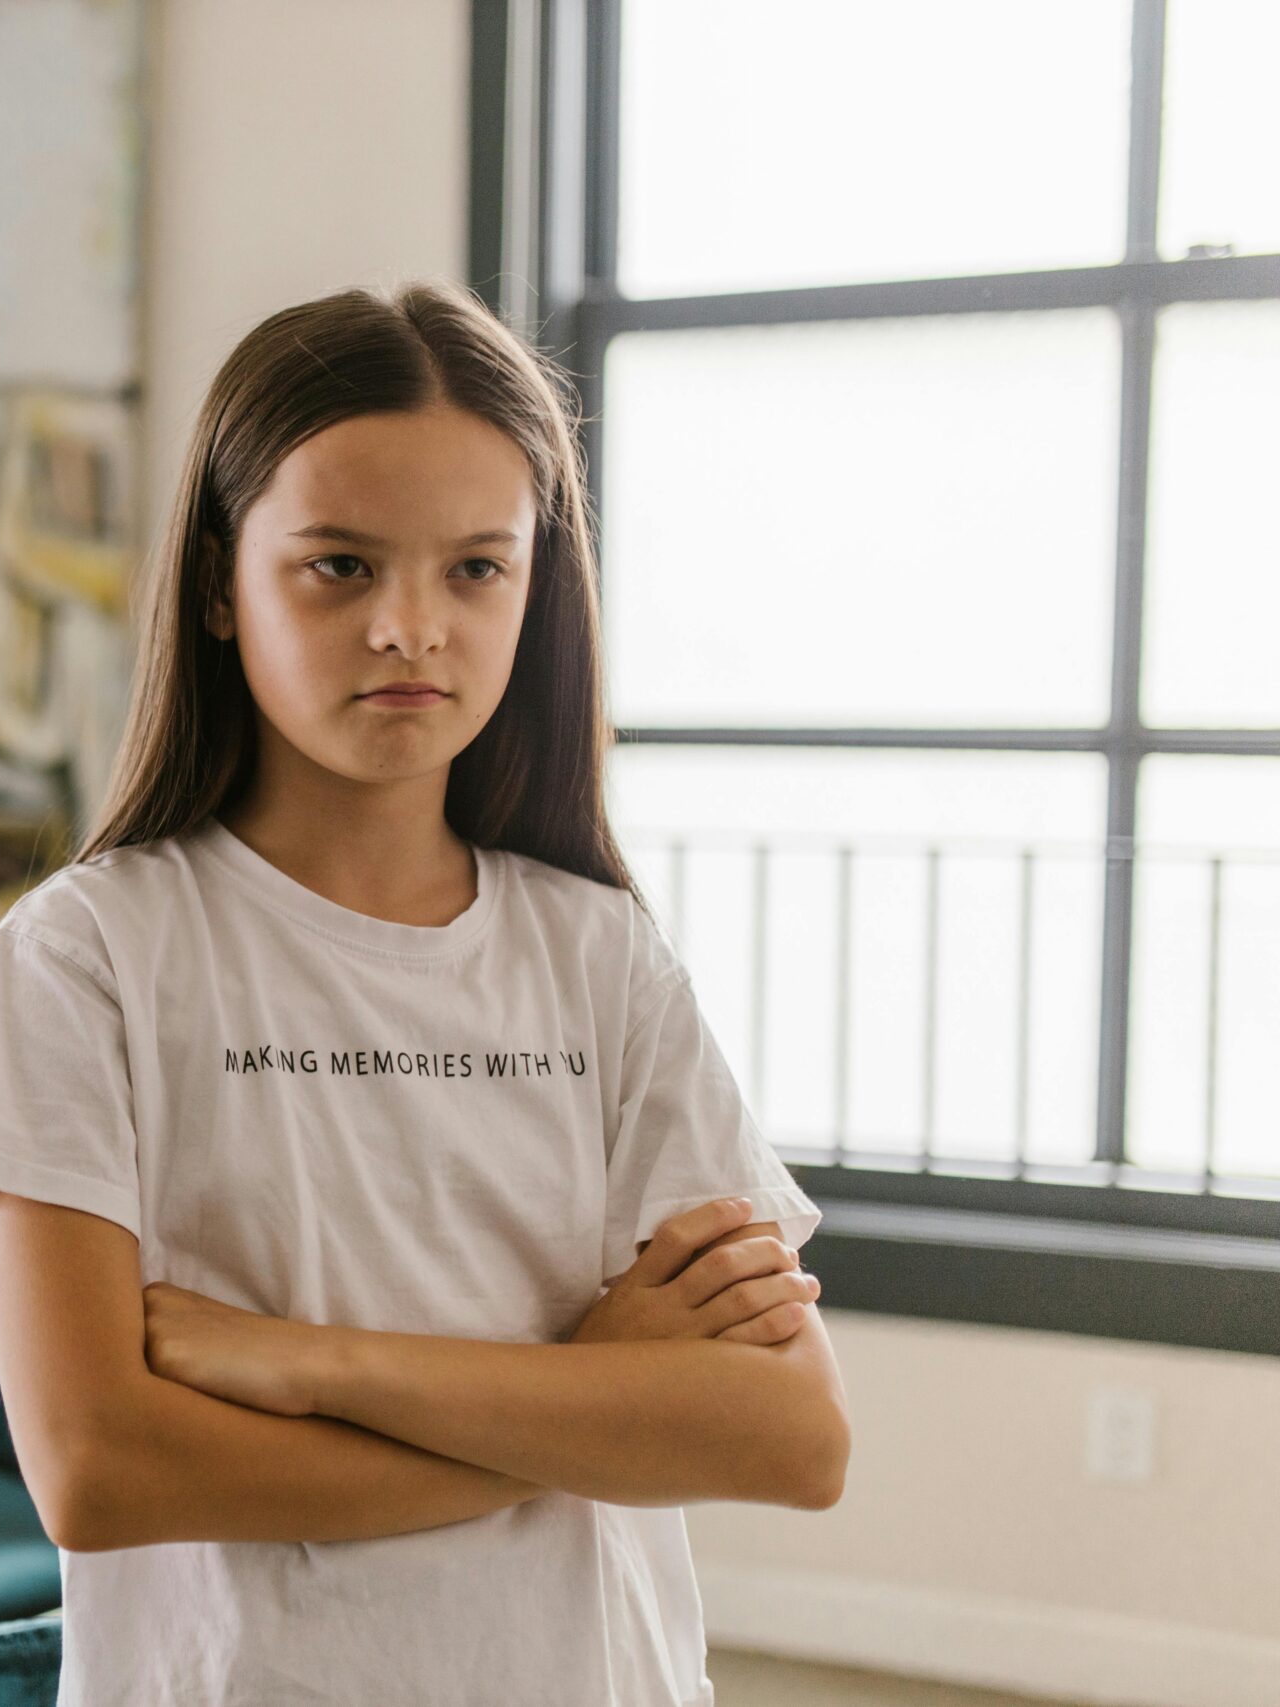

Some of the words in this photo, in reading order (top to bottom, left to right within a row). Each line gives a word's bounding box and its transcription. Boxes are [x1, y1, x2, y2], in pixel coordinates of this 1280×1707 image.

[225, 1044, 318, 1075] MAKING
[330, 1050, 472, 1078] MEMORIES
[485, 1052, 552, 1078] WITH
